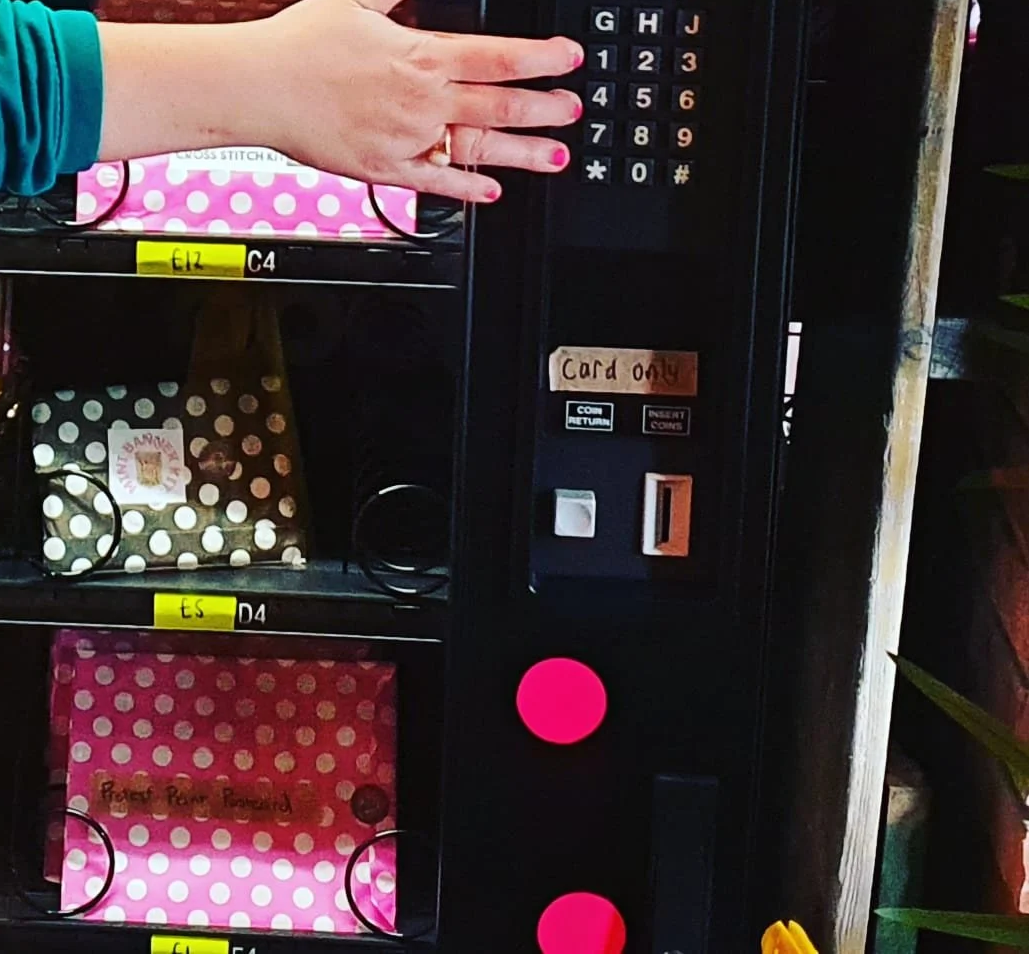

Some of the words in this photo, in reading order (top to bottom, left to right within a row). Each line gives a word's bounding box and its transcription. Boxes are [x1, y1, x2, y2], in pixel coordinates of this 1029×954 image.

[594, 11, 615, 32] G
[638, 12, 659, 34] H
[684, 14, 700, 35] J
[597, 49, 609, 69] 1
[637, 50, 654, 71] 2
[681, 51, 698, 72] 3
[591, 86, 608, 107] 4
[635, 87, 652, 108] 5
[678, 89, 695, 111] 6
[590, 123, 607, 144] 7
[633, 125, 649, 146] 8
[676, 127, 693, 148] 9
[220, 150, 264, 161] STITCH
[247, 249, 277, 273] C4
[561, 357, 618, 382] Card
[632, 358, 680, 384] only
[576, 405, 603, 416] COIN
[647, 409, 686, 420] INSERT
[568, 416, 611, 428] RETURN
[650, 420, 684, 432] COINS
[238, 602, 266, 624] D4
